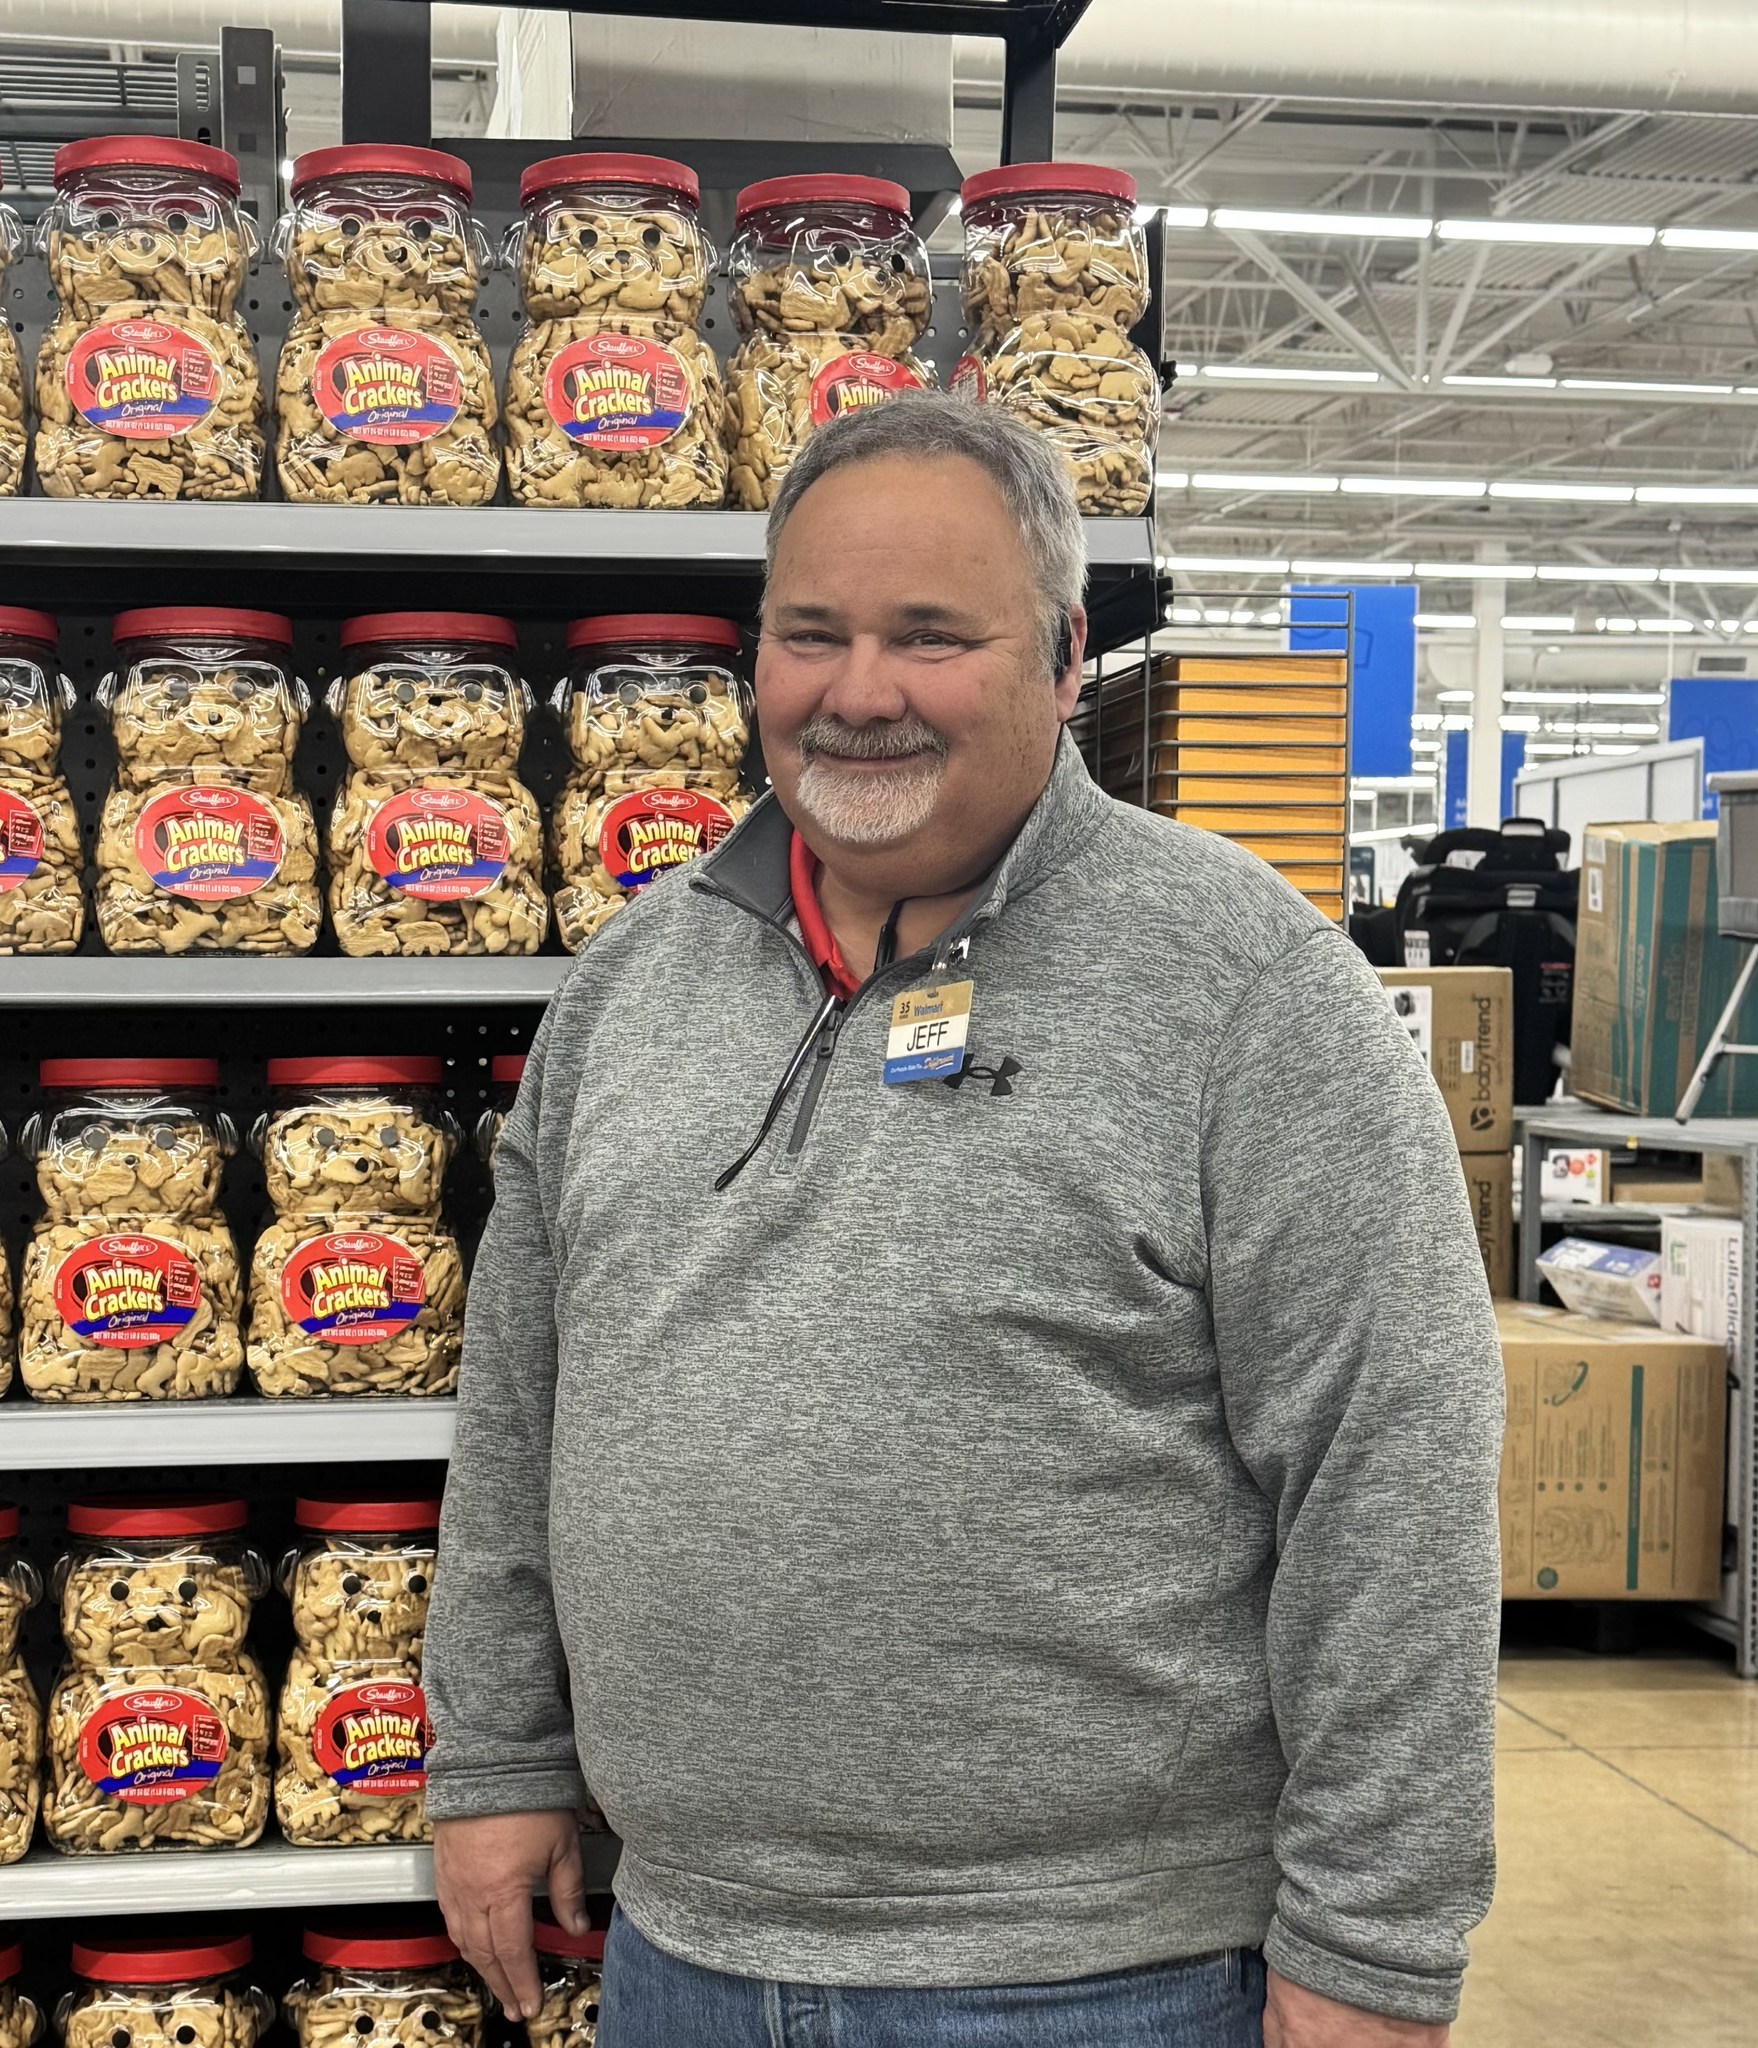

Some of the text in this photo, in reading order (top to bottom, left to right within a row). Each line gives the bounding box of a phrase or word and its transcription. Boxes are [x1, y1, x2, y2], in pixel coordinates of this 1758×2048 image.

[97, 345, 177, 381] Animal
[345, 353, 422, 387] Animal
[576, 360, 651, 396] Animal
[97, 373, 178, 409] Crackers
[345, 381, 423, 415] Crackers
[575, 389, 652, 422] Crackers
[838, 377, 892, 409] Anim
[121, 401, 164, 417] Original
[367, 408, 409, 424] Original
[597, 415, 638, 431] Original
[167, 811, 244, 846] Animal
[398, 812, 473, 846] Animal
[629, 813, 703, 847] Animal
[167, 838, 244, 872] Crackers
[398, 838, 474, 873] Crackers
[189, 865, 231, 880] Original
[420, 866, 460, 881] Original
[900, 1001, 944, 1017] 35 Walmart
[906, 1020, 949, 1052] JEFF
[85, 1260, 163, 1294] Animal
[312, 1257, 388, 1291] Animal
[85, 1286, 164, 1320] Crackers
[312, 1283, 389, 1318] Crackers
[335, 1309, 375, 1325] Original
[108, 1312, 149, 1329] Original
[111, 1715, 188, 1751] Animal
[345, 1708, 420, 1744] Animal
[111, 1742, 189, 1778] Crackers
[345, 1733, 421, 1770] Crackers
[367, 1759, 408, 1776] Original
[133, 1767, 175, 1785] Original
